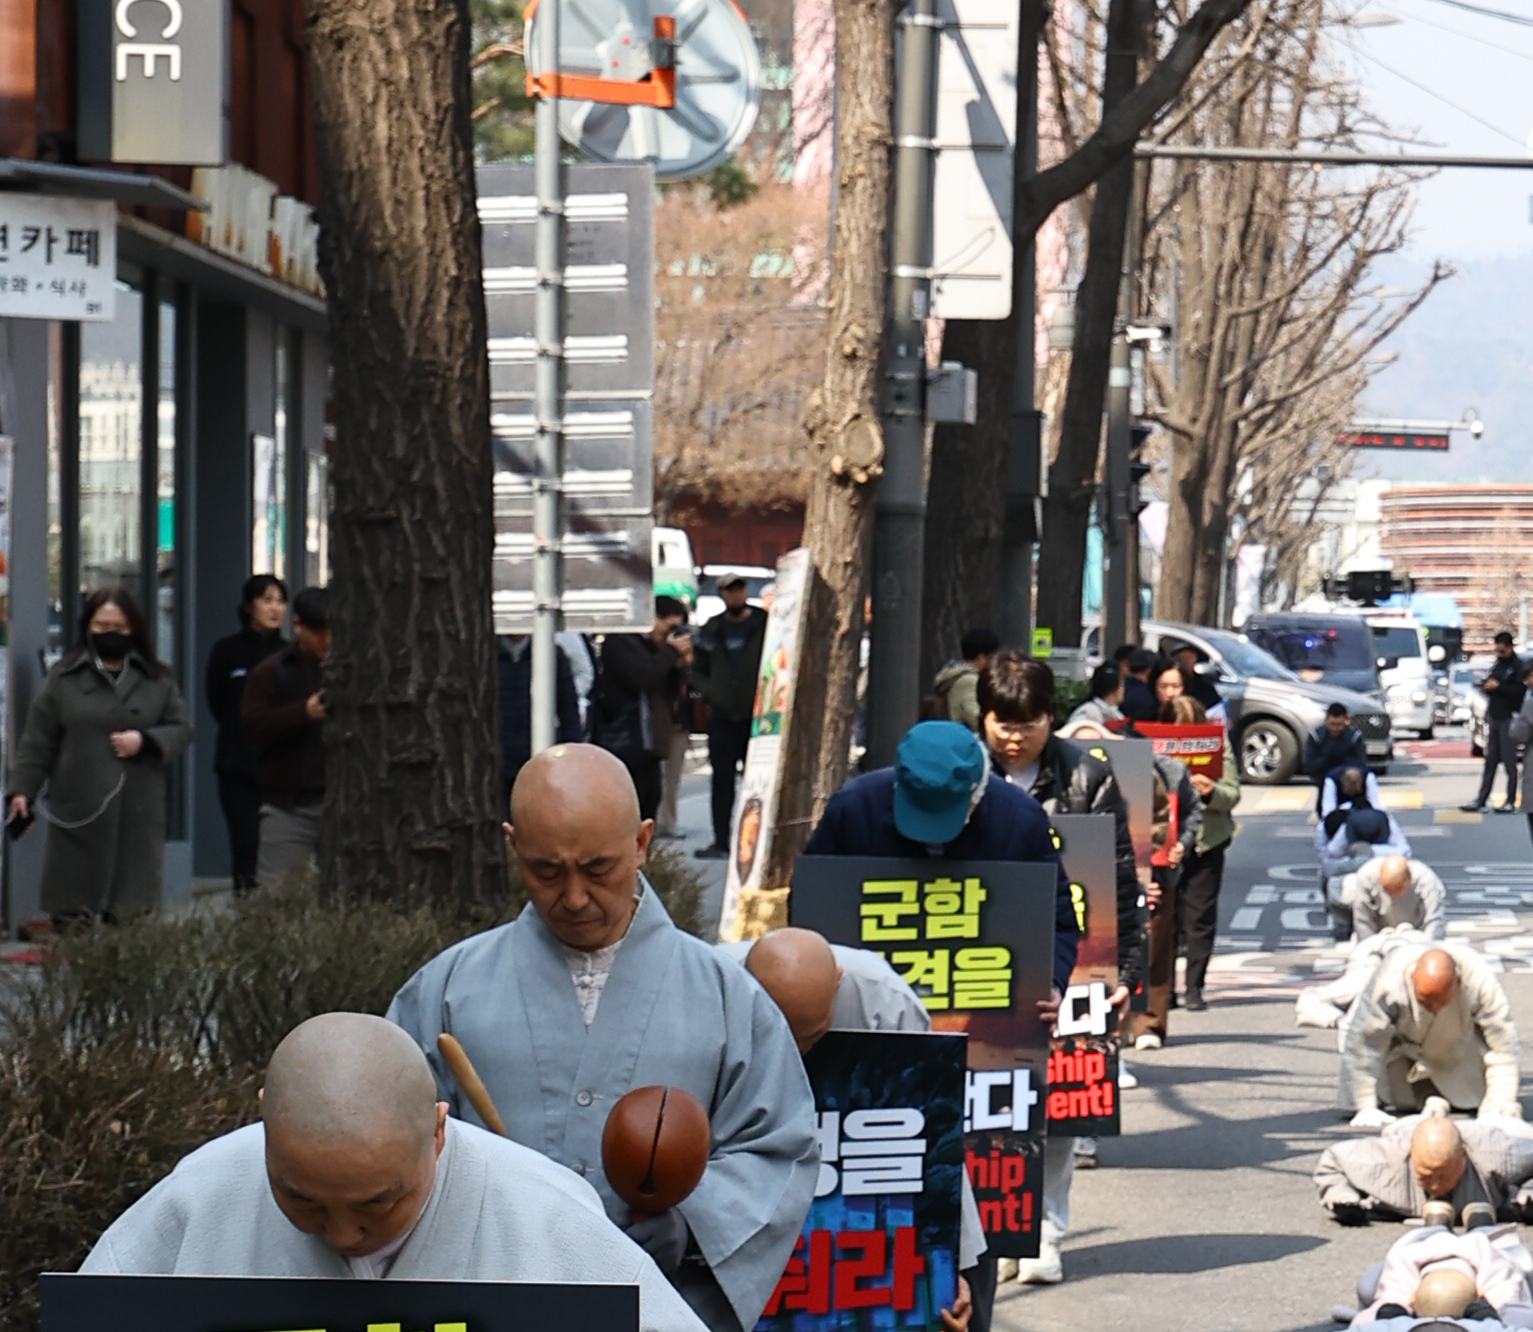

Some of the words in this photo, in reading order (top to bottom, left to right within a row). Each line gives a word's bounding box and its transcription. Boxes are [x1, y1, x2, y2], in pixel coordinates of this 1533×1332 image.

[115, 0, 182, 82] CE
[860, 877, 987, 941] 군함
[876, 946, 1012, 1010] 견을
[764, 1226, 925, 1316] 춰라
